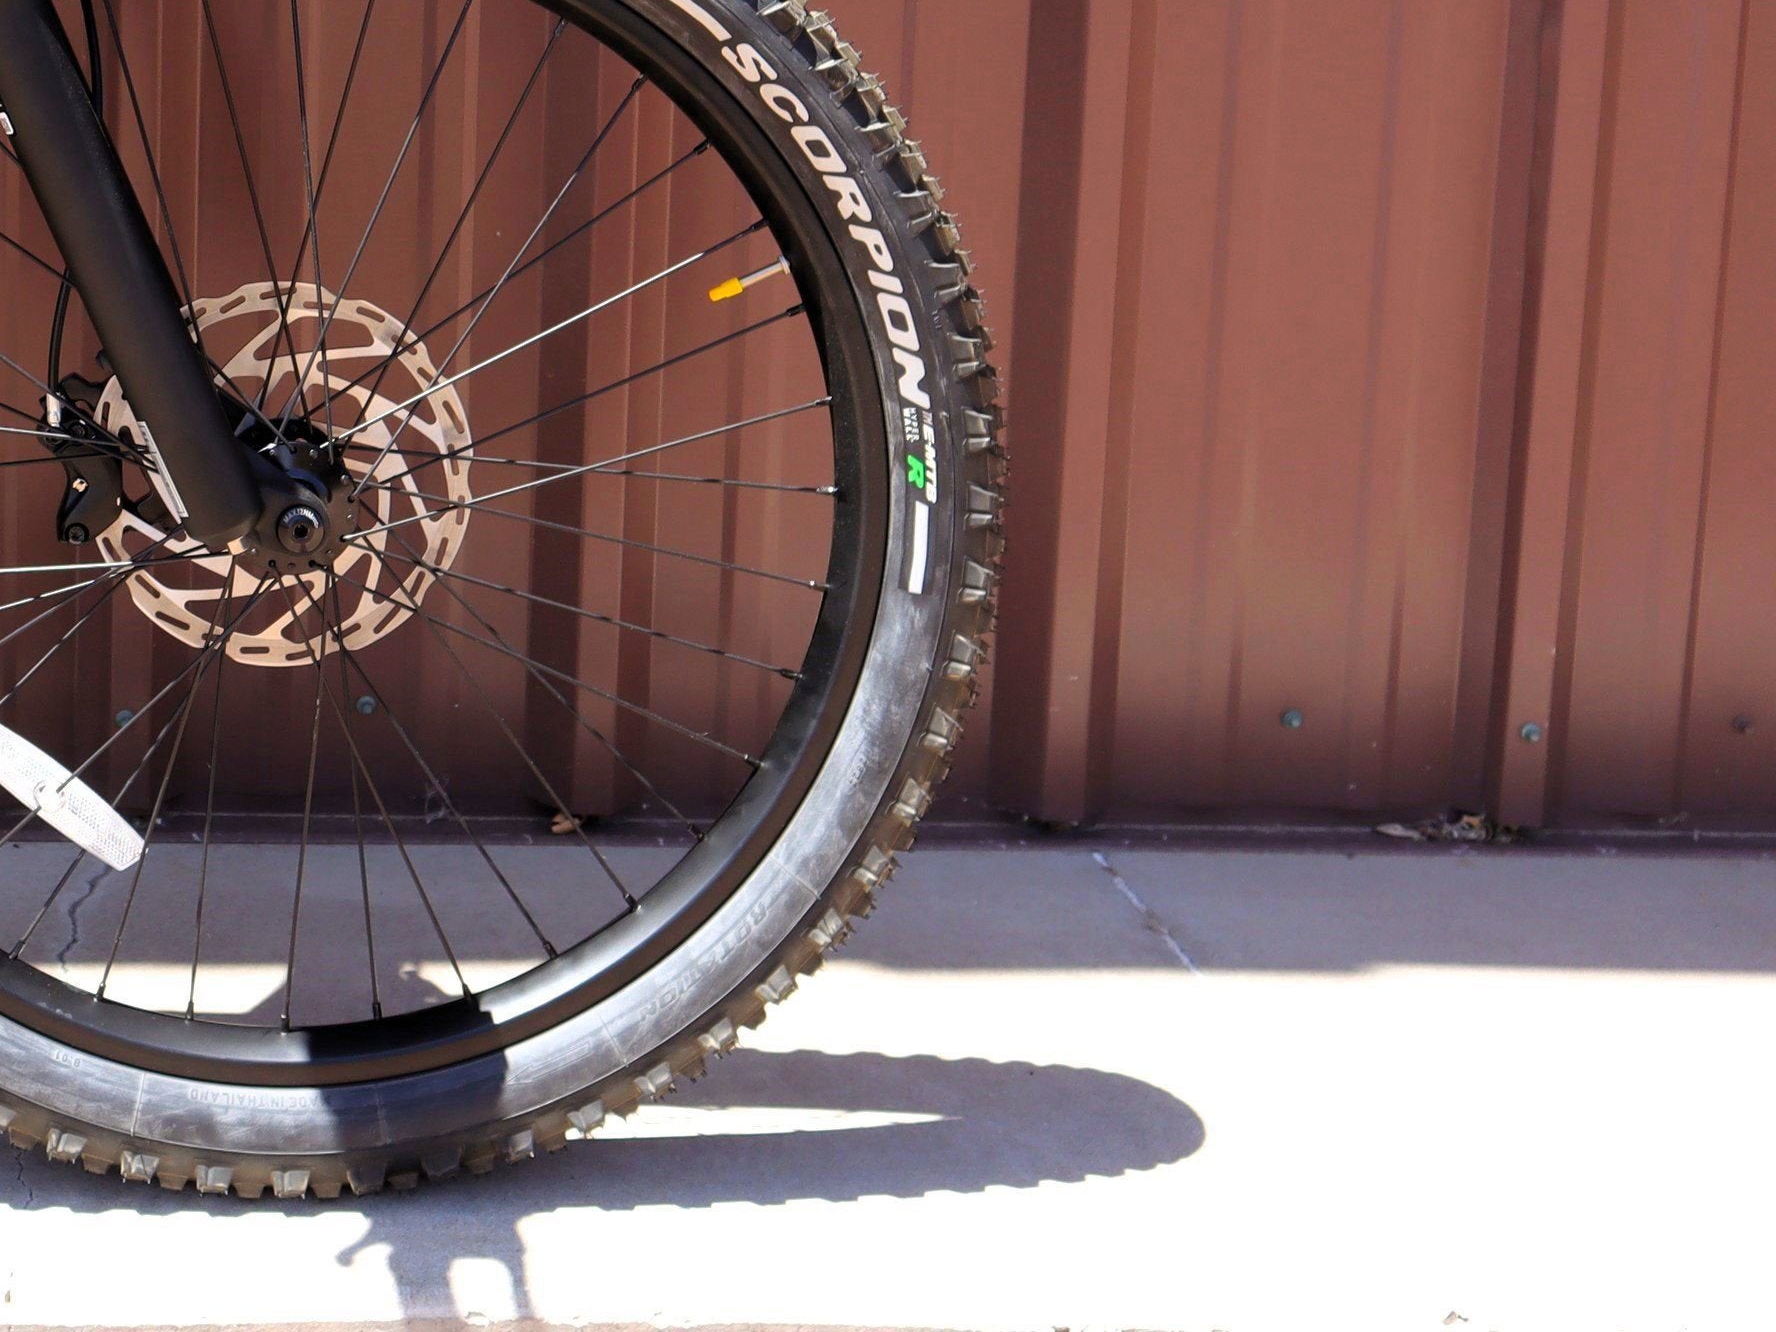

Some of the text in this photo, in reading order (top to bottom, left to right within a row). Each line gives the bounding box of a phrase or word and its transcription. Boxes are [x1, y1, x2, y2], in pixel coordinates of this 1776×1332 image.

[721, 42, 930, 409] SCORPION
[910, 408, 920, 443] HYPER
[907, 455, 924, 488] R
